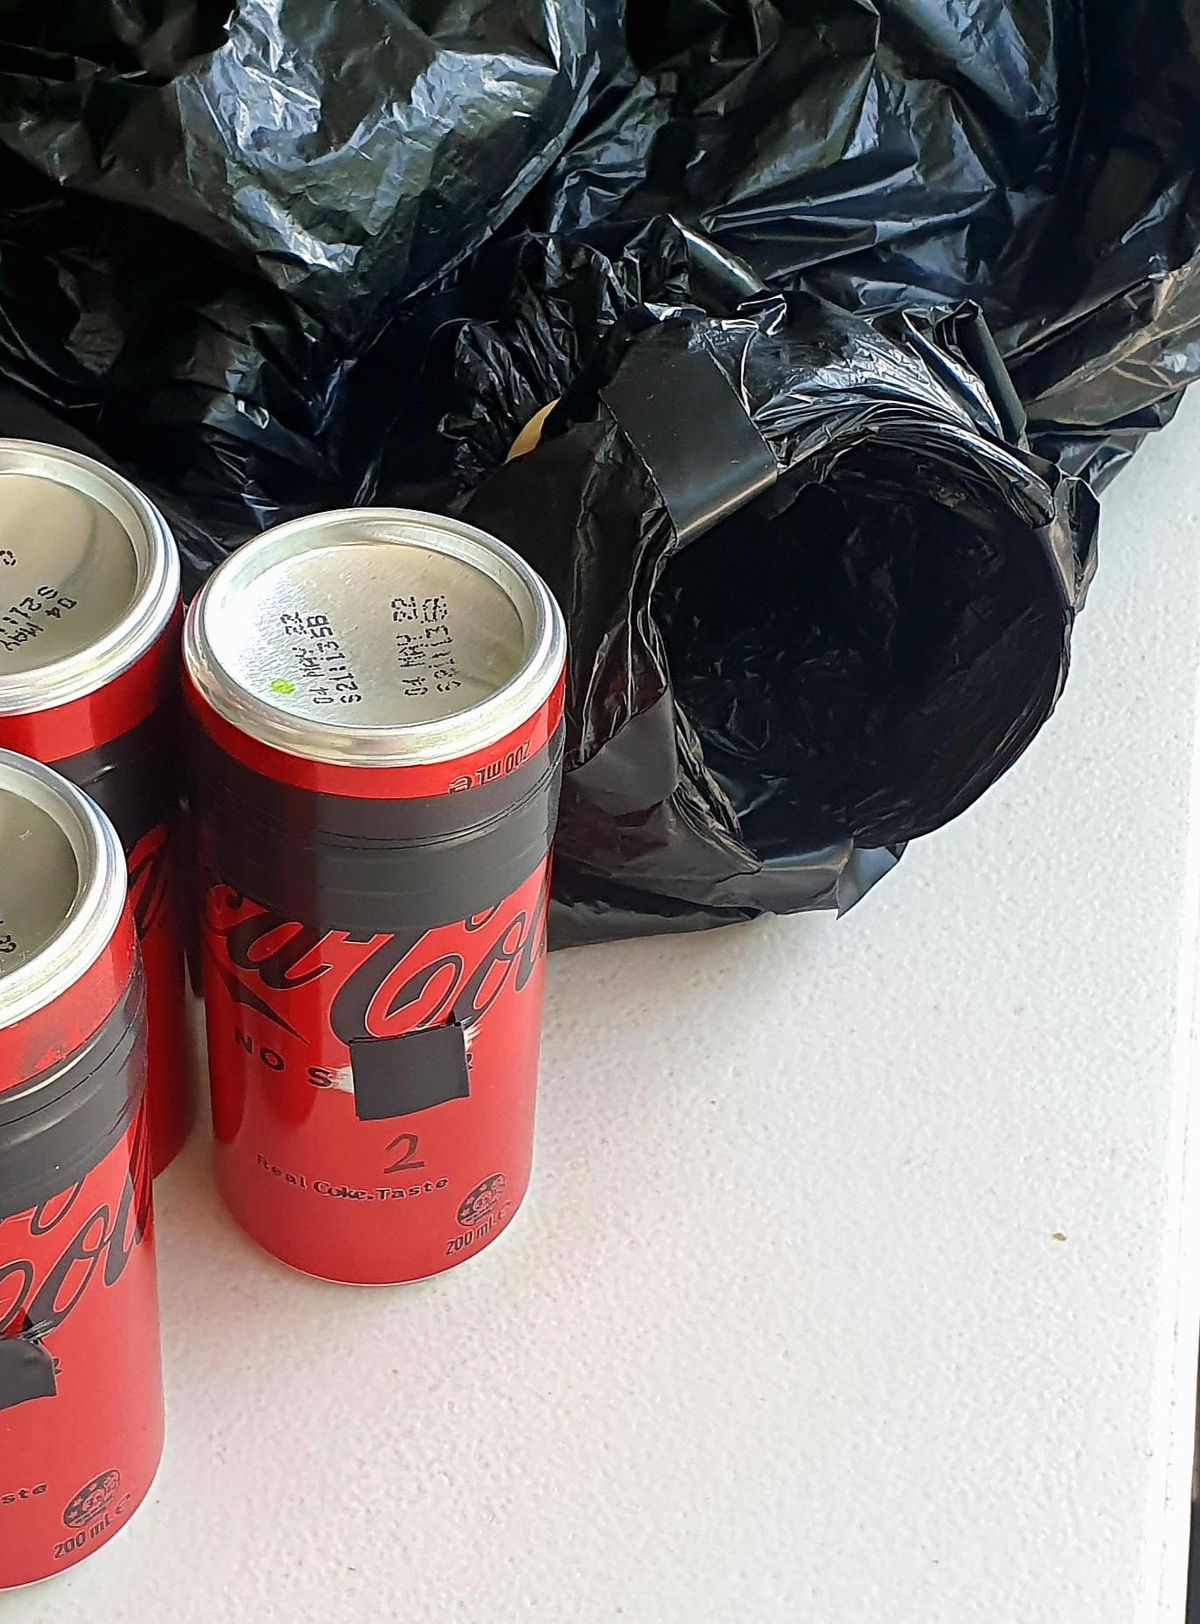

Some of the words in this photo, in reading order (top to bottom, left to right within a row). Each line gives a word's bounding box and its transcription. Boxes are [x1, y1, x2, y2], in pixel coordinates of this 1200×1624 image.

[46, 597, 78, 620] 04
[0, 618, 46, 653] MAY
[504, 740, 531, 767] 200
[234, 1023, 285, 1072] NO
[383, 1133, 425, 1175] 2
[256, 1153, 308, 1189] Real
[376, 1176, 449, 1200] Taste
[446, 1230, 473, 1256] 200
[54, 1530, 86, 1559] 200
